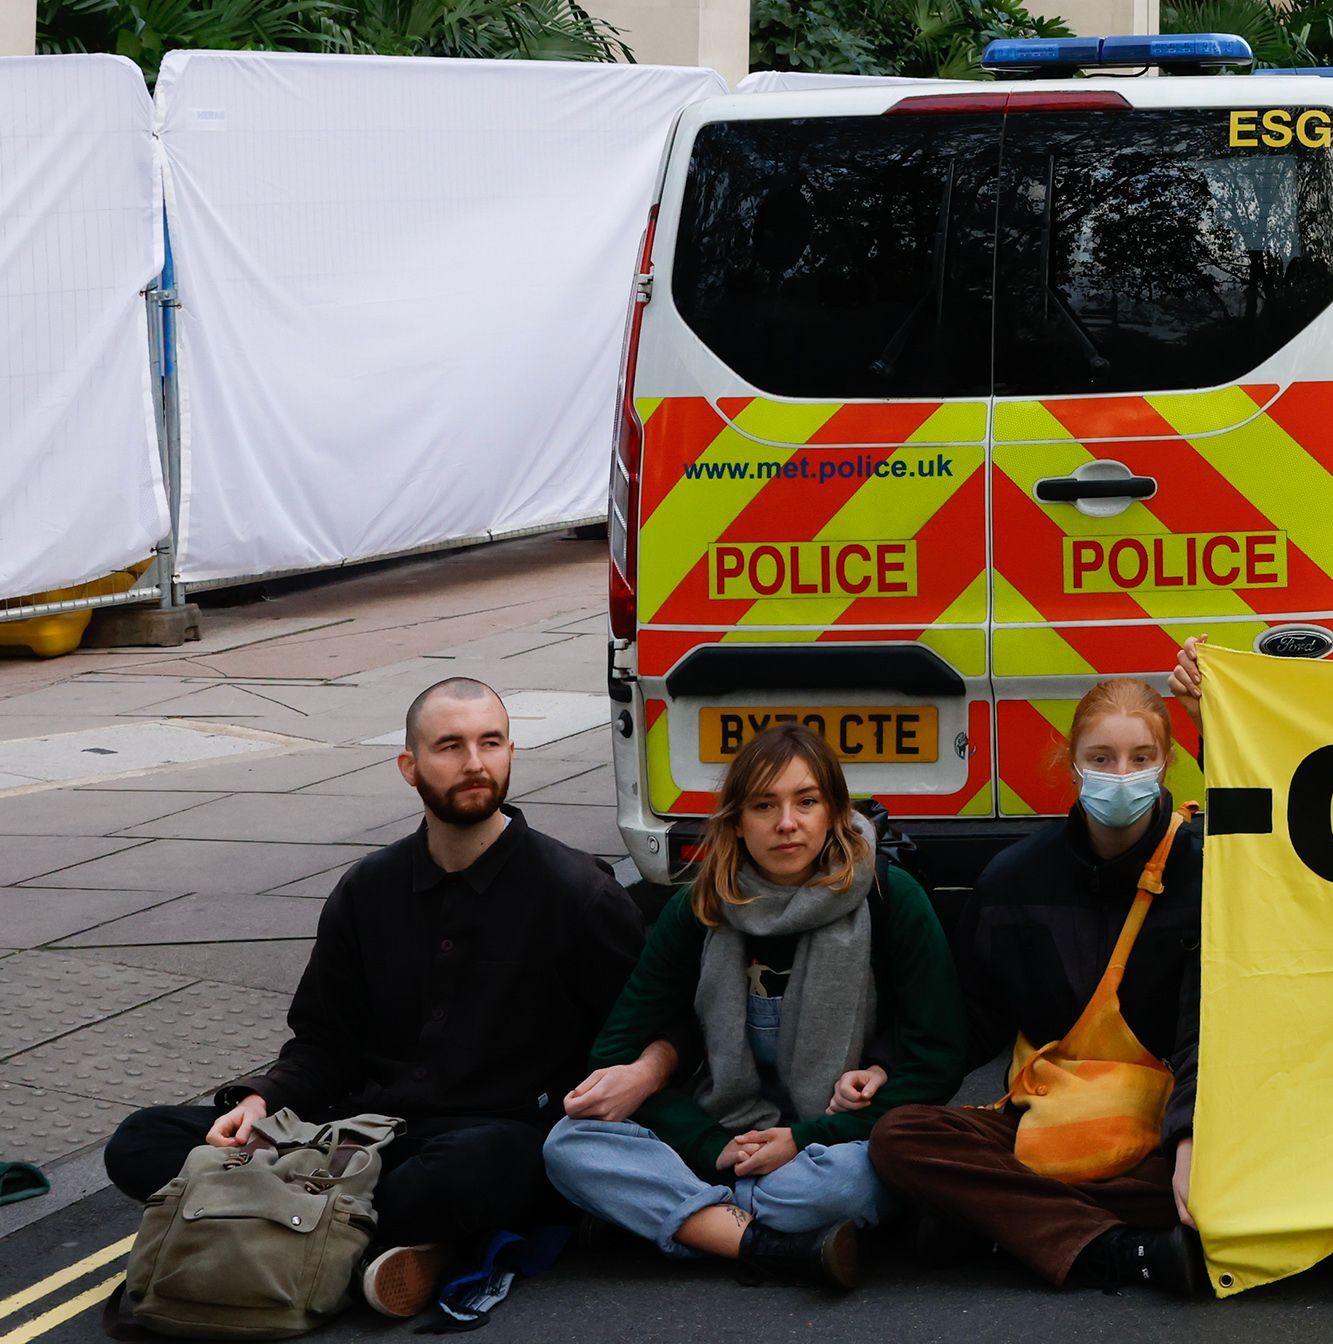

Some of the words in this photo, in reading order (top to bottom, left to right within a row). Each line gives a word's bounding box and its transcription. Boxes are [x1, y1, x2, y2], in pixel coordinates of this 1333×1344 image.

[1229, 109, 1331, 148] ESG
[684, 454, 954, 484] www.met.police.uk
[716, 543, 908, 595] POLICE
[1072, 535, 1278, 588] POLICE
[1276, 634, 1317, 652] Ford
[720, 714, 826, 755] BY0
[840, 714, 920, 754] CTE
